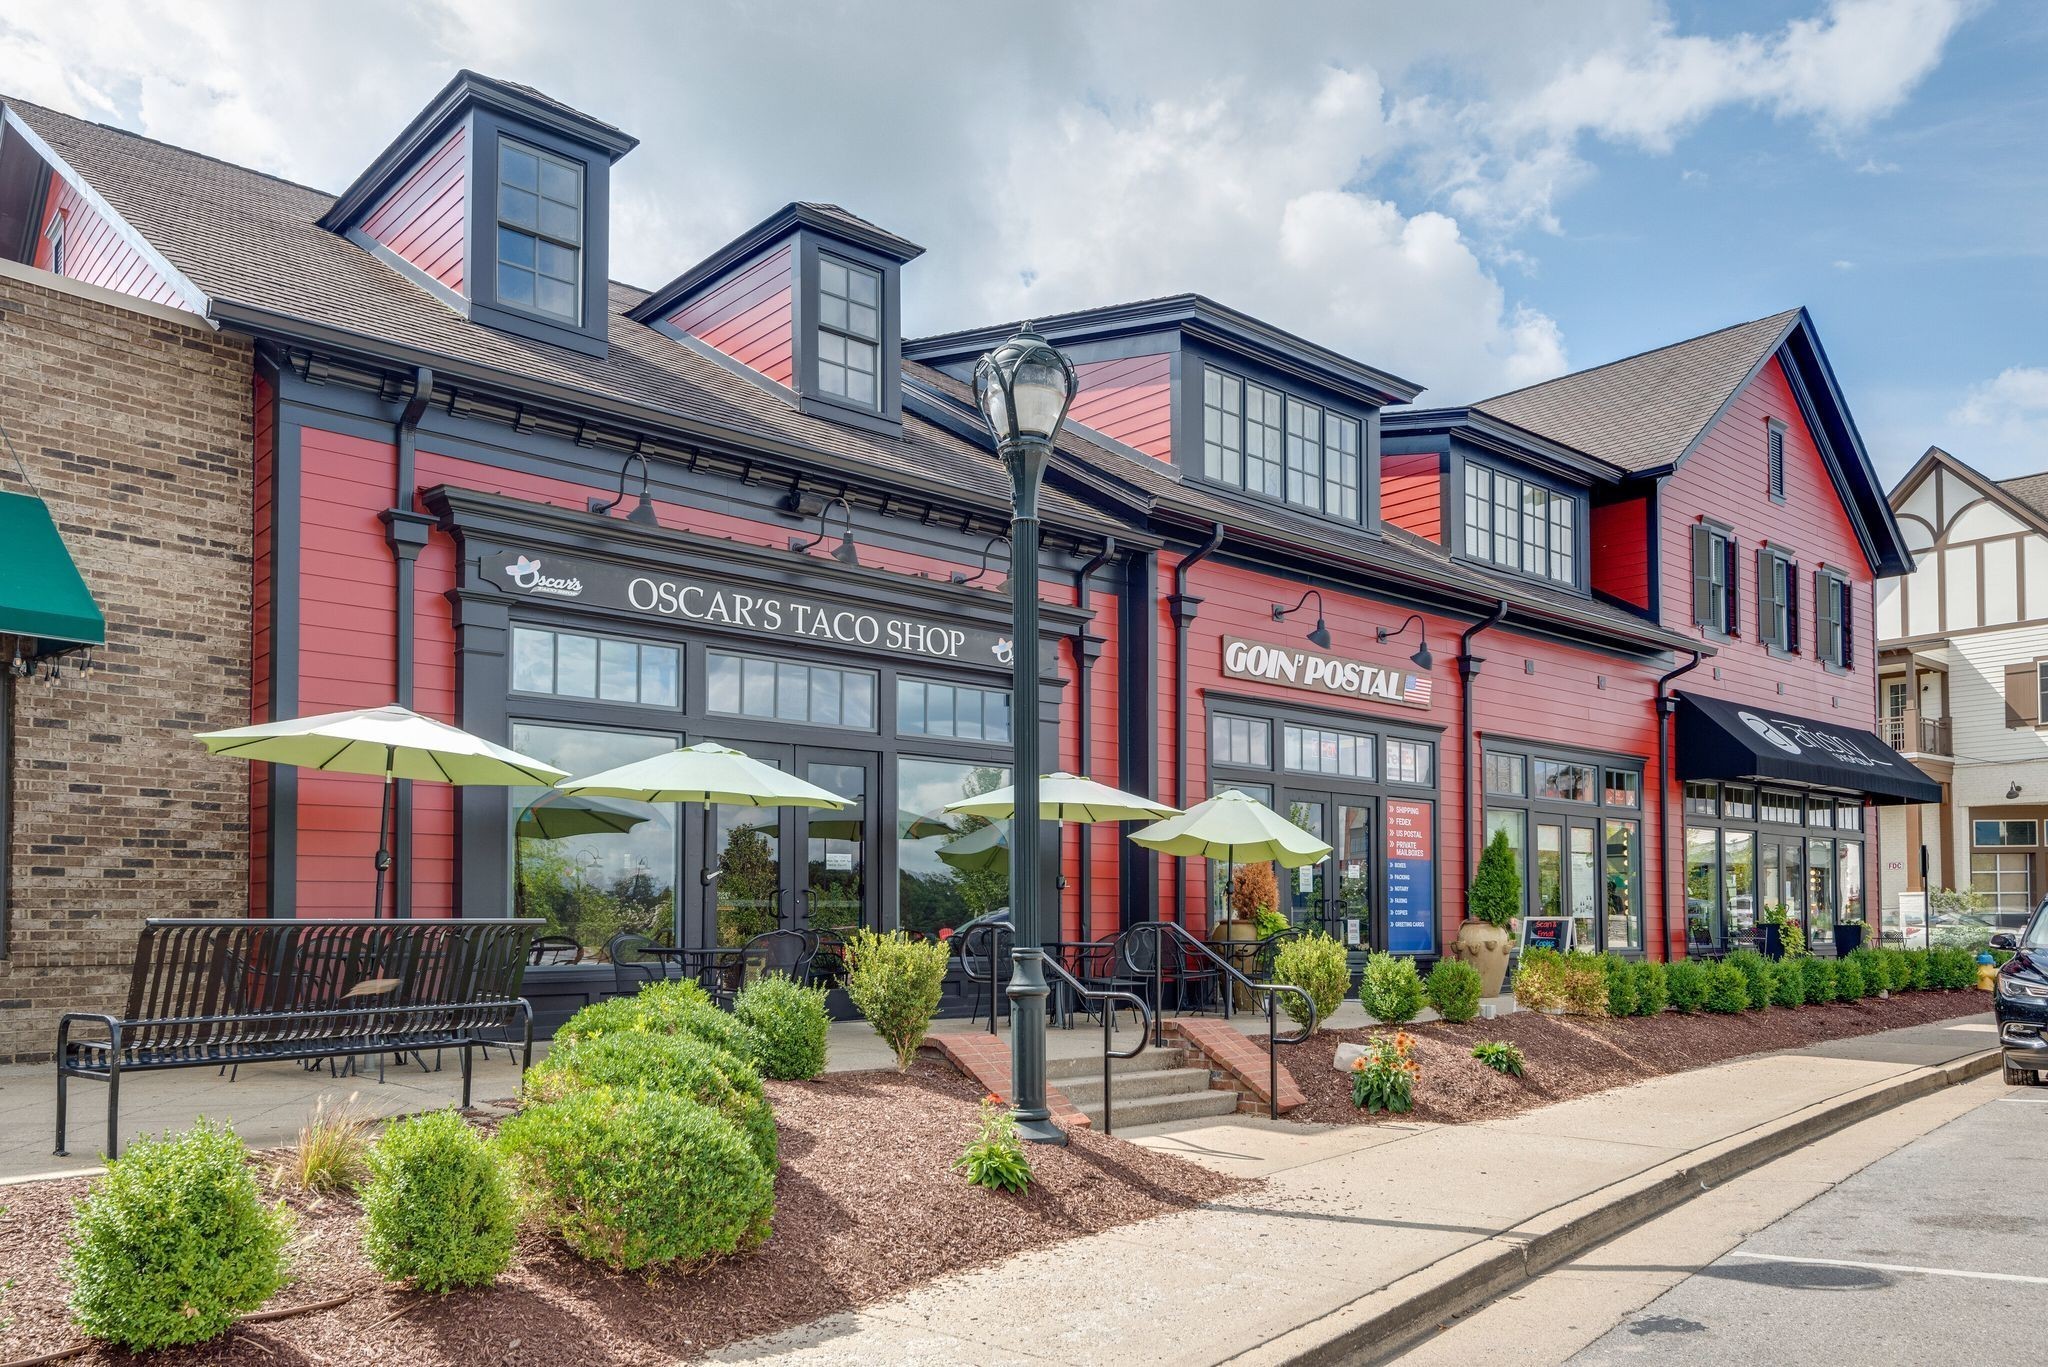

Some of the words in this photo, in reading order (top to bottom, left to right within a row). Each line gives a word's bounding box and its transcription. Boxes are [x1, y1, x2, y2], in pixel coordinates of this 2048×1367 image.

[514, 566, 583, 592] Oscar's
[628, 577, 782, 631] OSCAR'S
[789, 603, 880, 645] TACO
[885, 620, 966, 658] SHOP
[1225, 641, 1304, 683] GOIN'
[1303, 656, 1403, 702] POSTAL
[1387, 748, 1414, 765] FeEx
[1396, 806, 1419, 815] SHIPPING
[1396, 817, 1412, 826] FEDEX
[1396, 829, 1403, 837] US
[1404, 830, 1423, 838] POSTAL
[1396, 840, 1417, 849] PRIVATE
[1396, 848, 1424, 857] MAILBOXES
